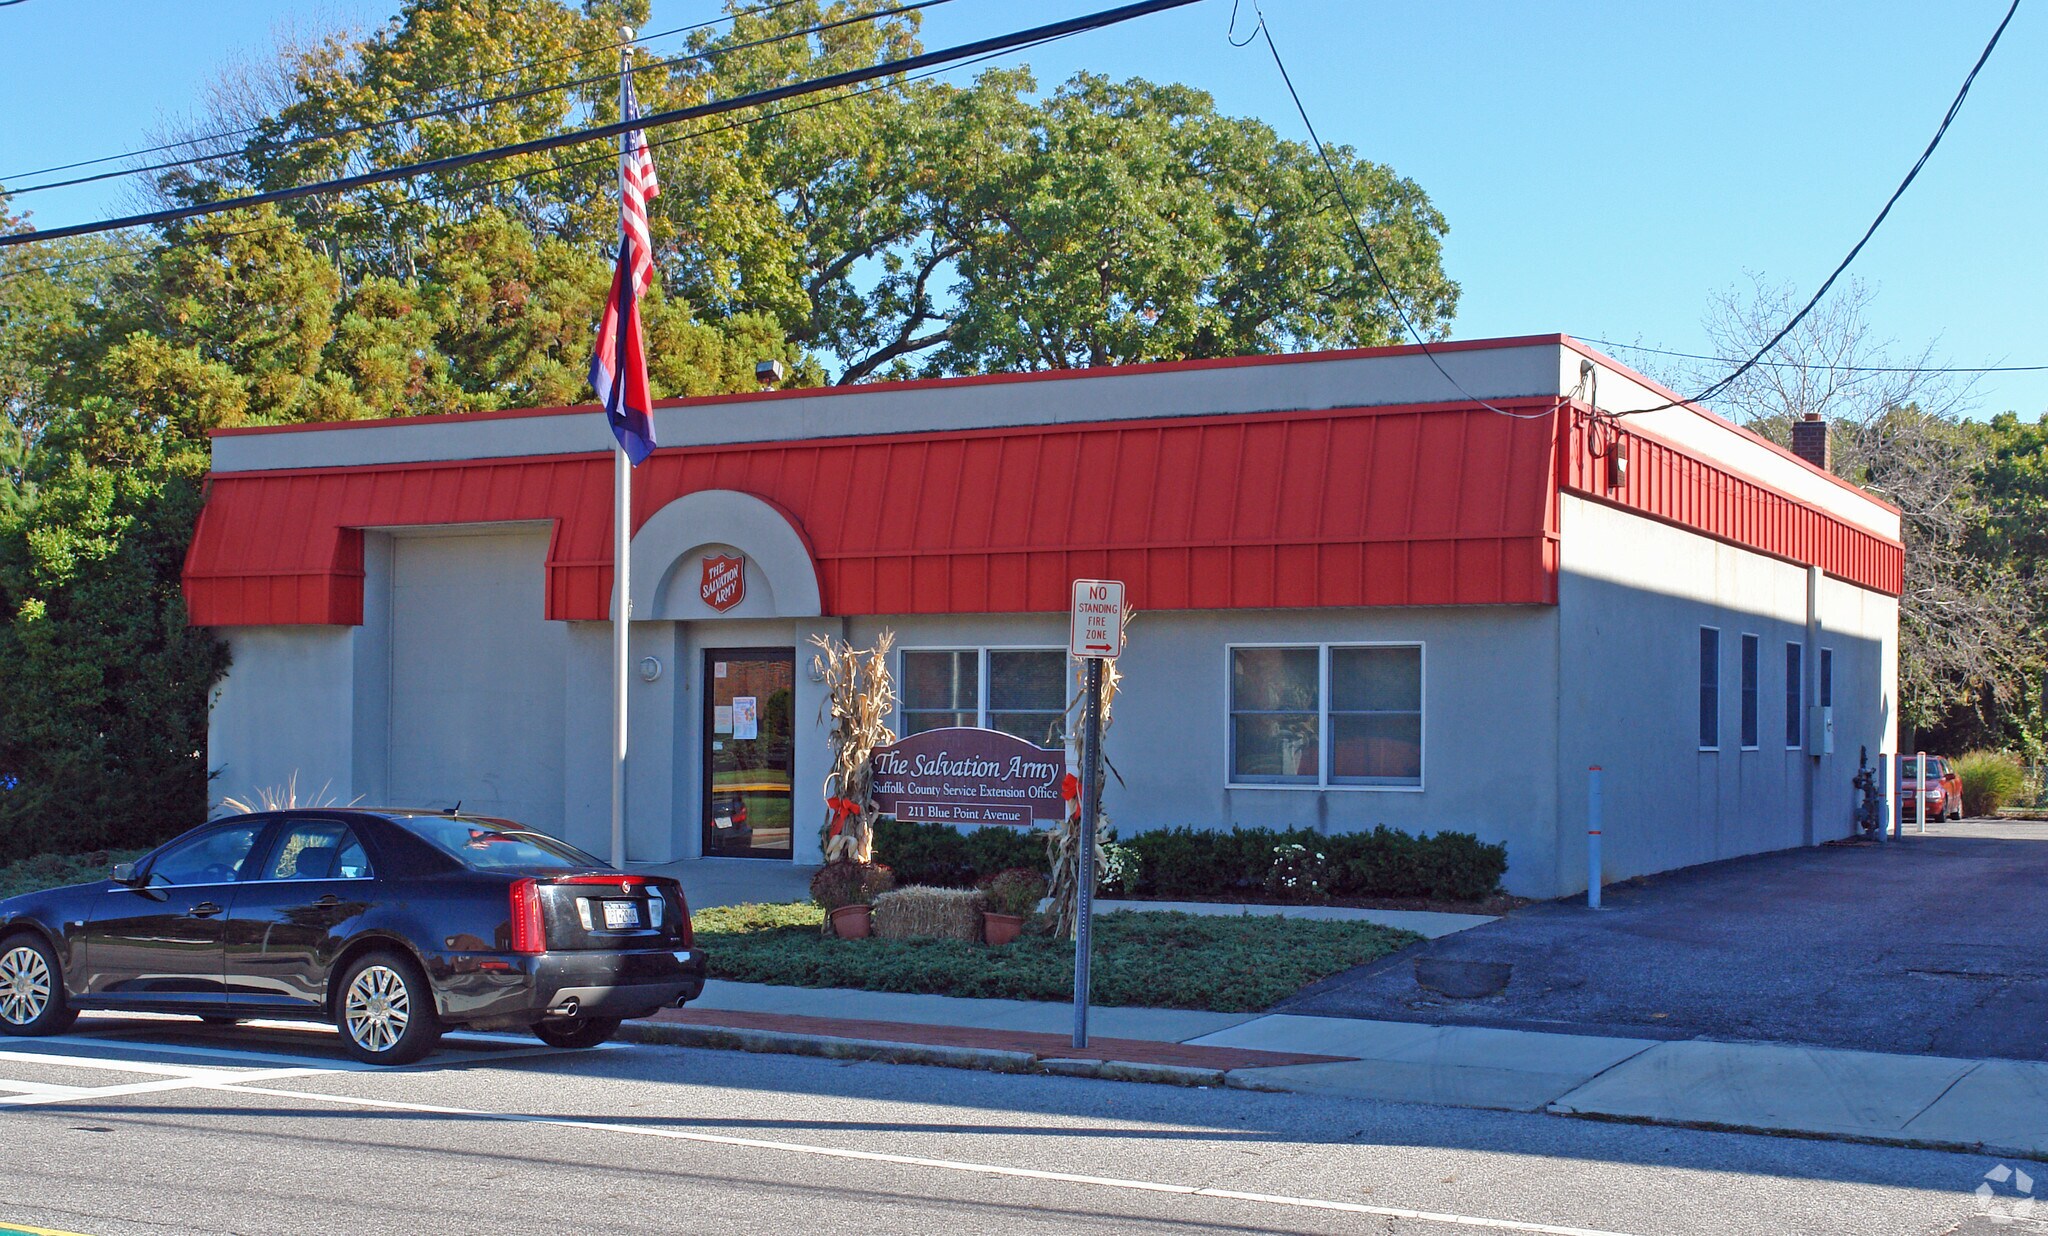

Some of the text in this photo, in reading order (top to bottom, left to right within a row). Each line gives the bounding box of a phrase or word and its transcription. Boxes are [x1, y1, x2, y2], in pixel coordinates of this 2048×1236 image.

[709, 562, 724, 579] THE
[703, 564, 738, 598] SALVATION
[715, 580, 736, 605] ARMY
[1089, 586, 1107, 600] NO
[1079, 603, 1117, 614] STANDING
[1088, 616, 1106, 626] FIRE
[1086, 630, 1107, 640] ZONE
[874, 750, 1059, 787] The Salvation Army
[873, 781, 1058, 799] Suffolk County Service Extension Office
[908, 806, 1021, 821] 211 Blue Point Avenue
